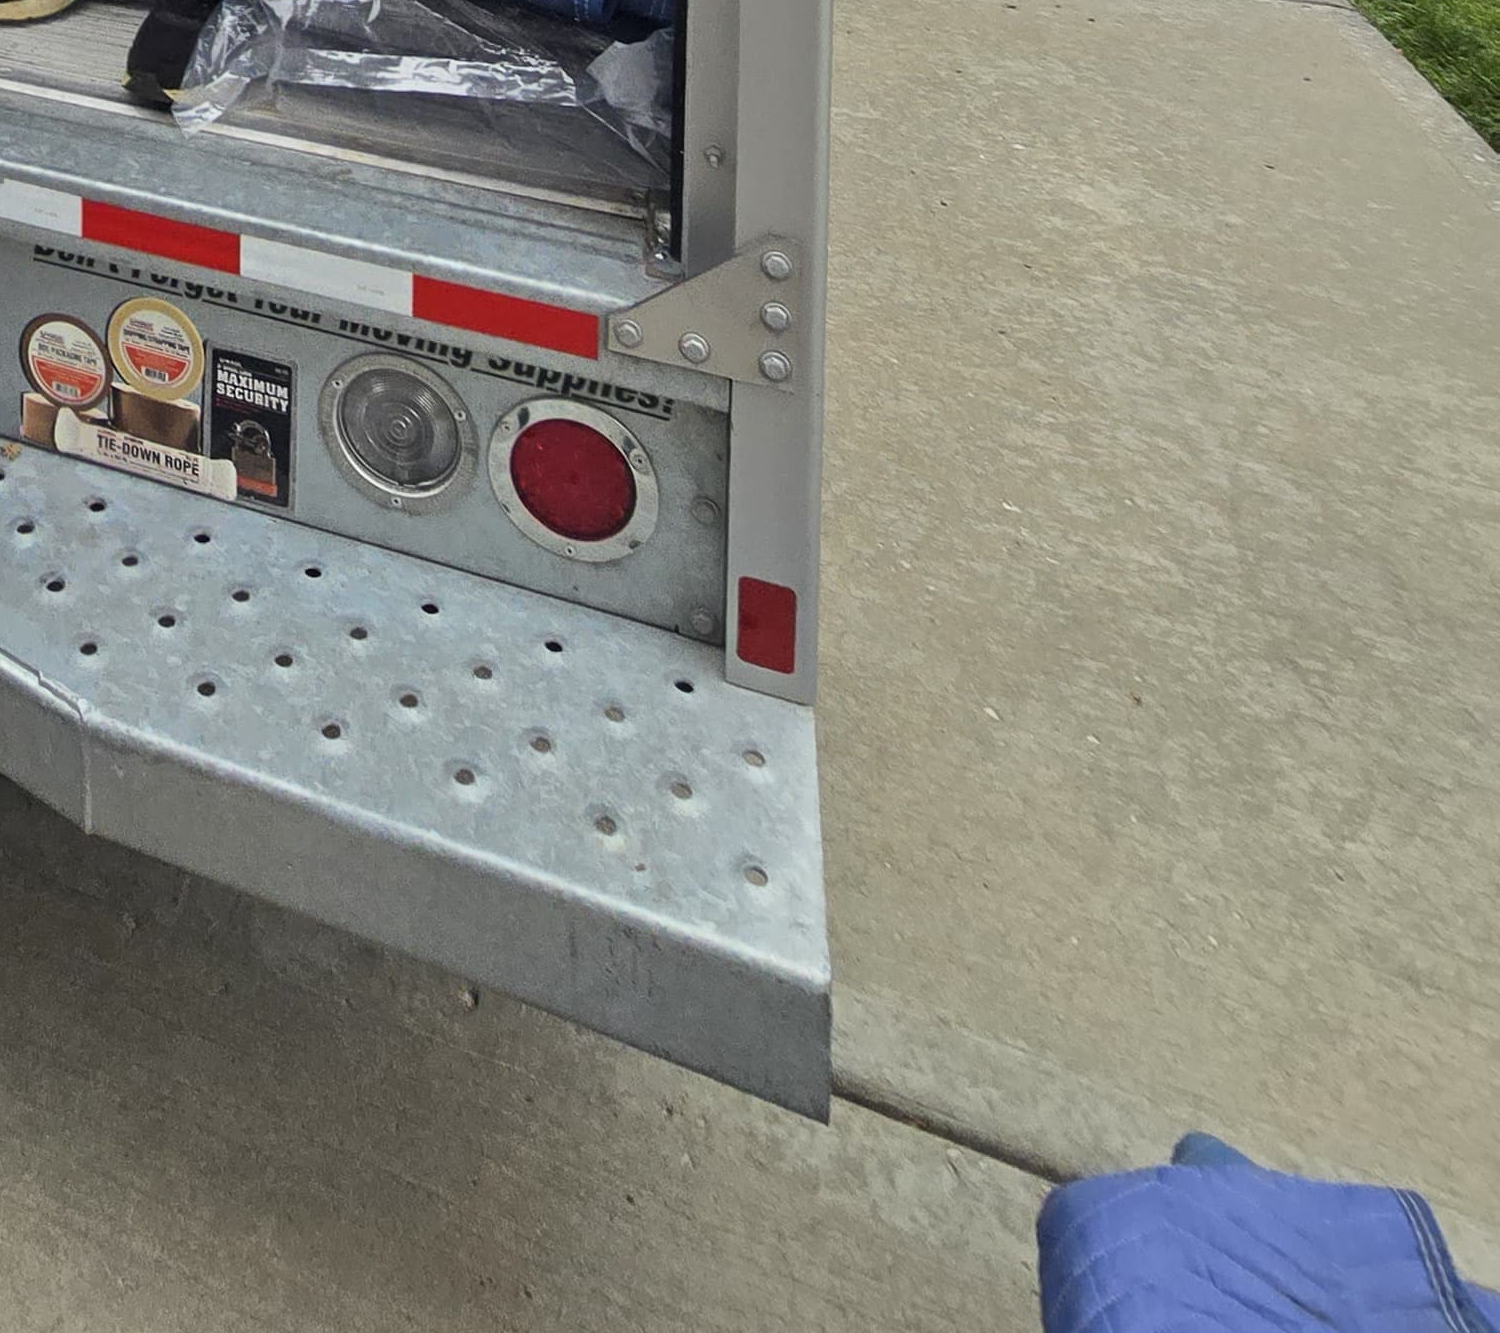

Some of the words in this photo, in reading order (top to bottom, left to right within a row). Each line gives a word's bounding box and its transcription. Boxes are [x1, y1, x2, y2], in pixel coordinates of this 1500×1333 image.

[216, 382, 289, 412] SECURITY
[217, 369, 288, 399] MAXIMUM
[97, 434, 160, 465] TIE-DOWN
[165, 454, 200, 477] ROPE
